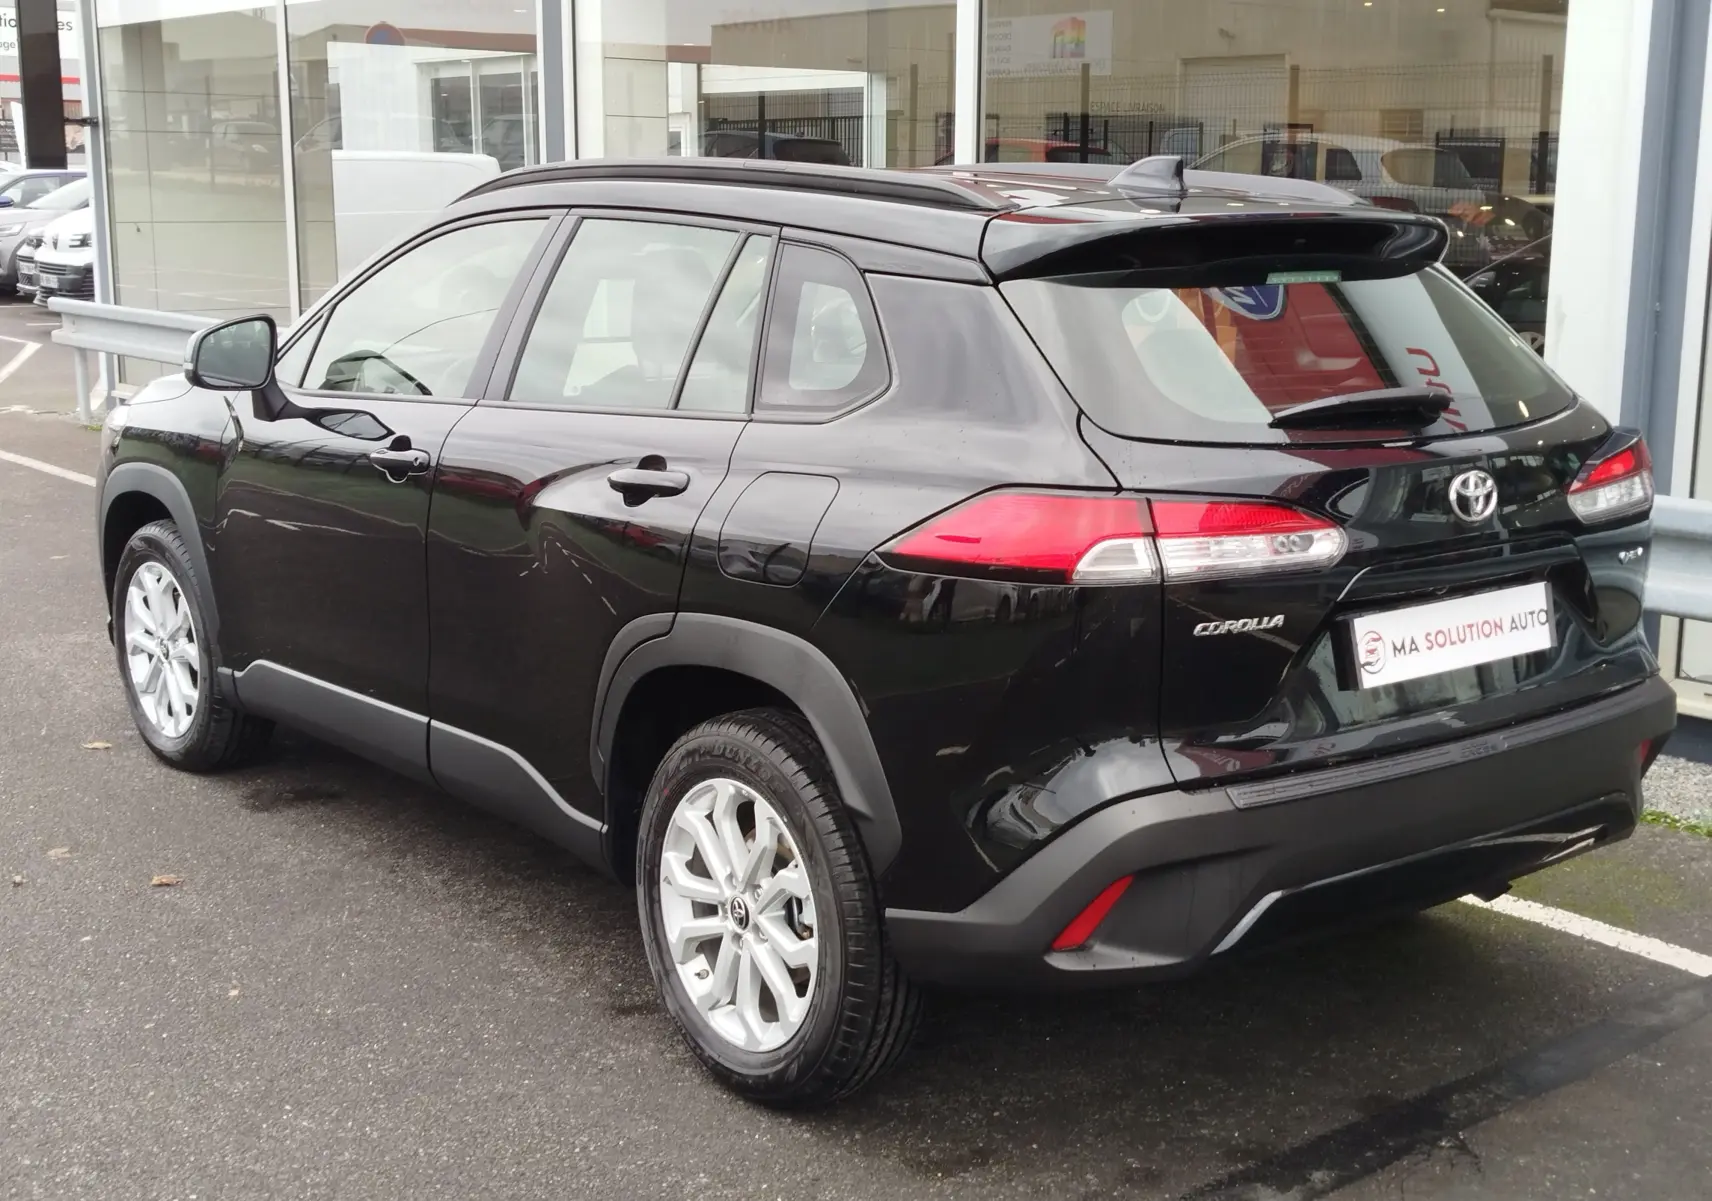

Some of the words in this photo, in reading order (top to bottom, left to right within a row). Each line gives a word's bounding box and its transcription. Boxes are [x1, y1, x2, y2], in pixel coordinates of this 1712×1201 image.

[1193, 614, 1285, 636] COROLLA
[1392, 636, 1420, 658] MA
[1424, 616, 1504, 651] SOLUTION
[1509, 608, 1549, 633] AUTO
